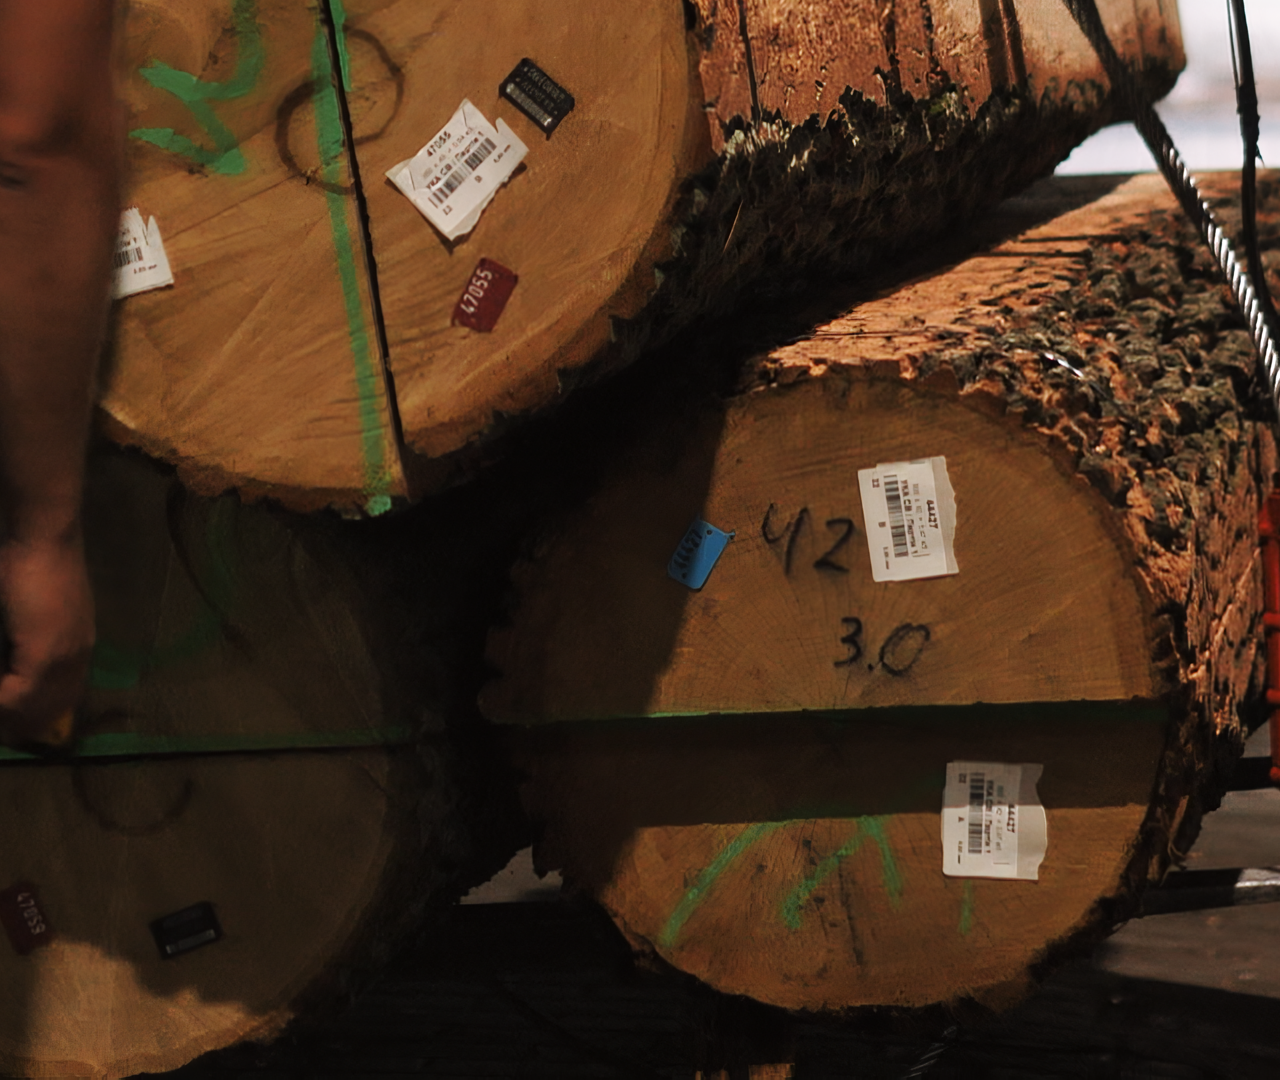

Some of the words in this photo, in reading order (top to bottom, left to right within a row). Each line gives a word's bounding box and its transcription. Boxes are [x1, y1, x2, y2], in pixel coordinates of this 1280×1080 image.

[426, 130, 452, 158] 47055
[460, 268, 492, 314] 47055
[760, 502, 855, 576] 42
[833, 616, 931, 677] 3.0
